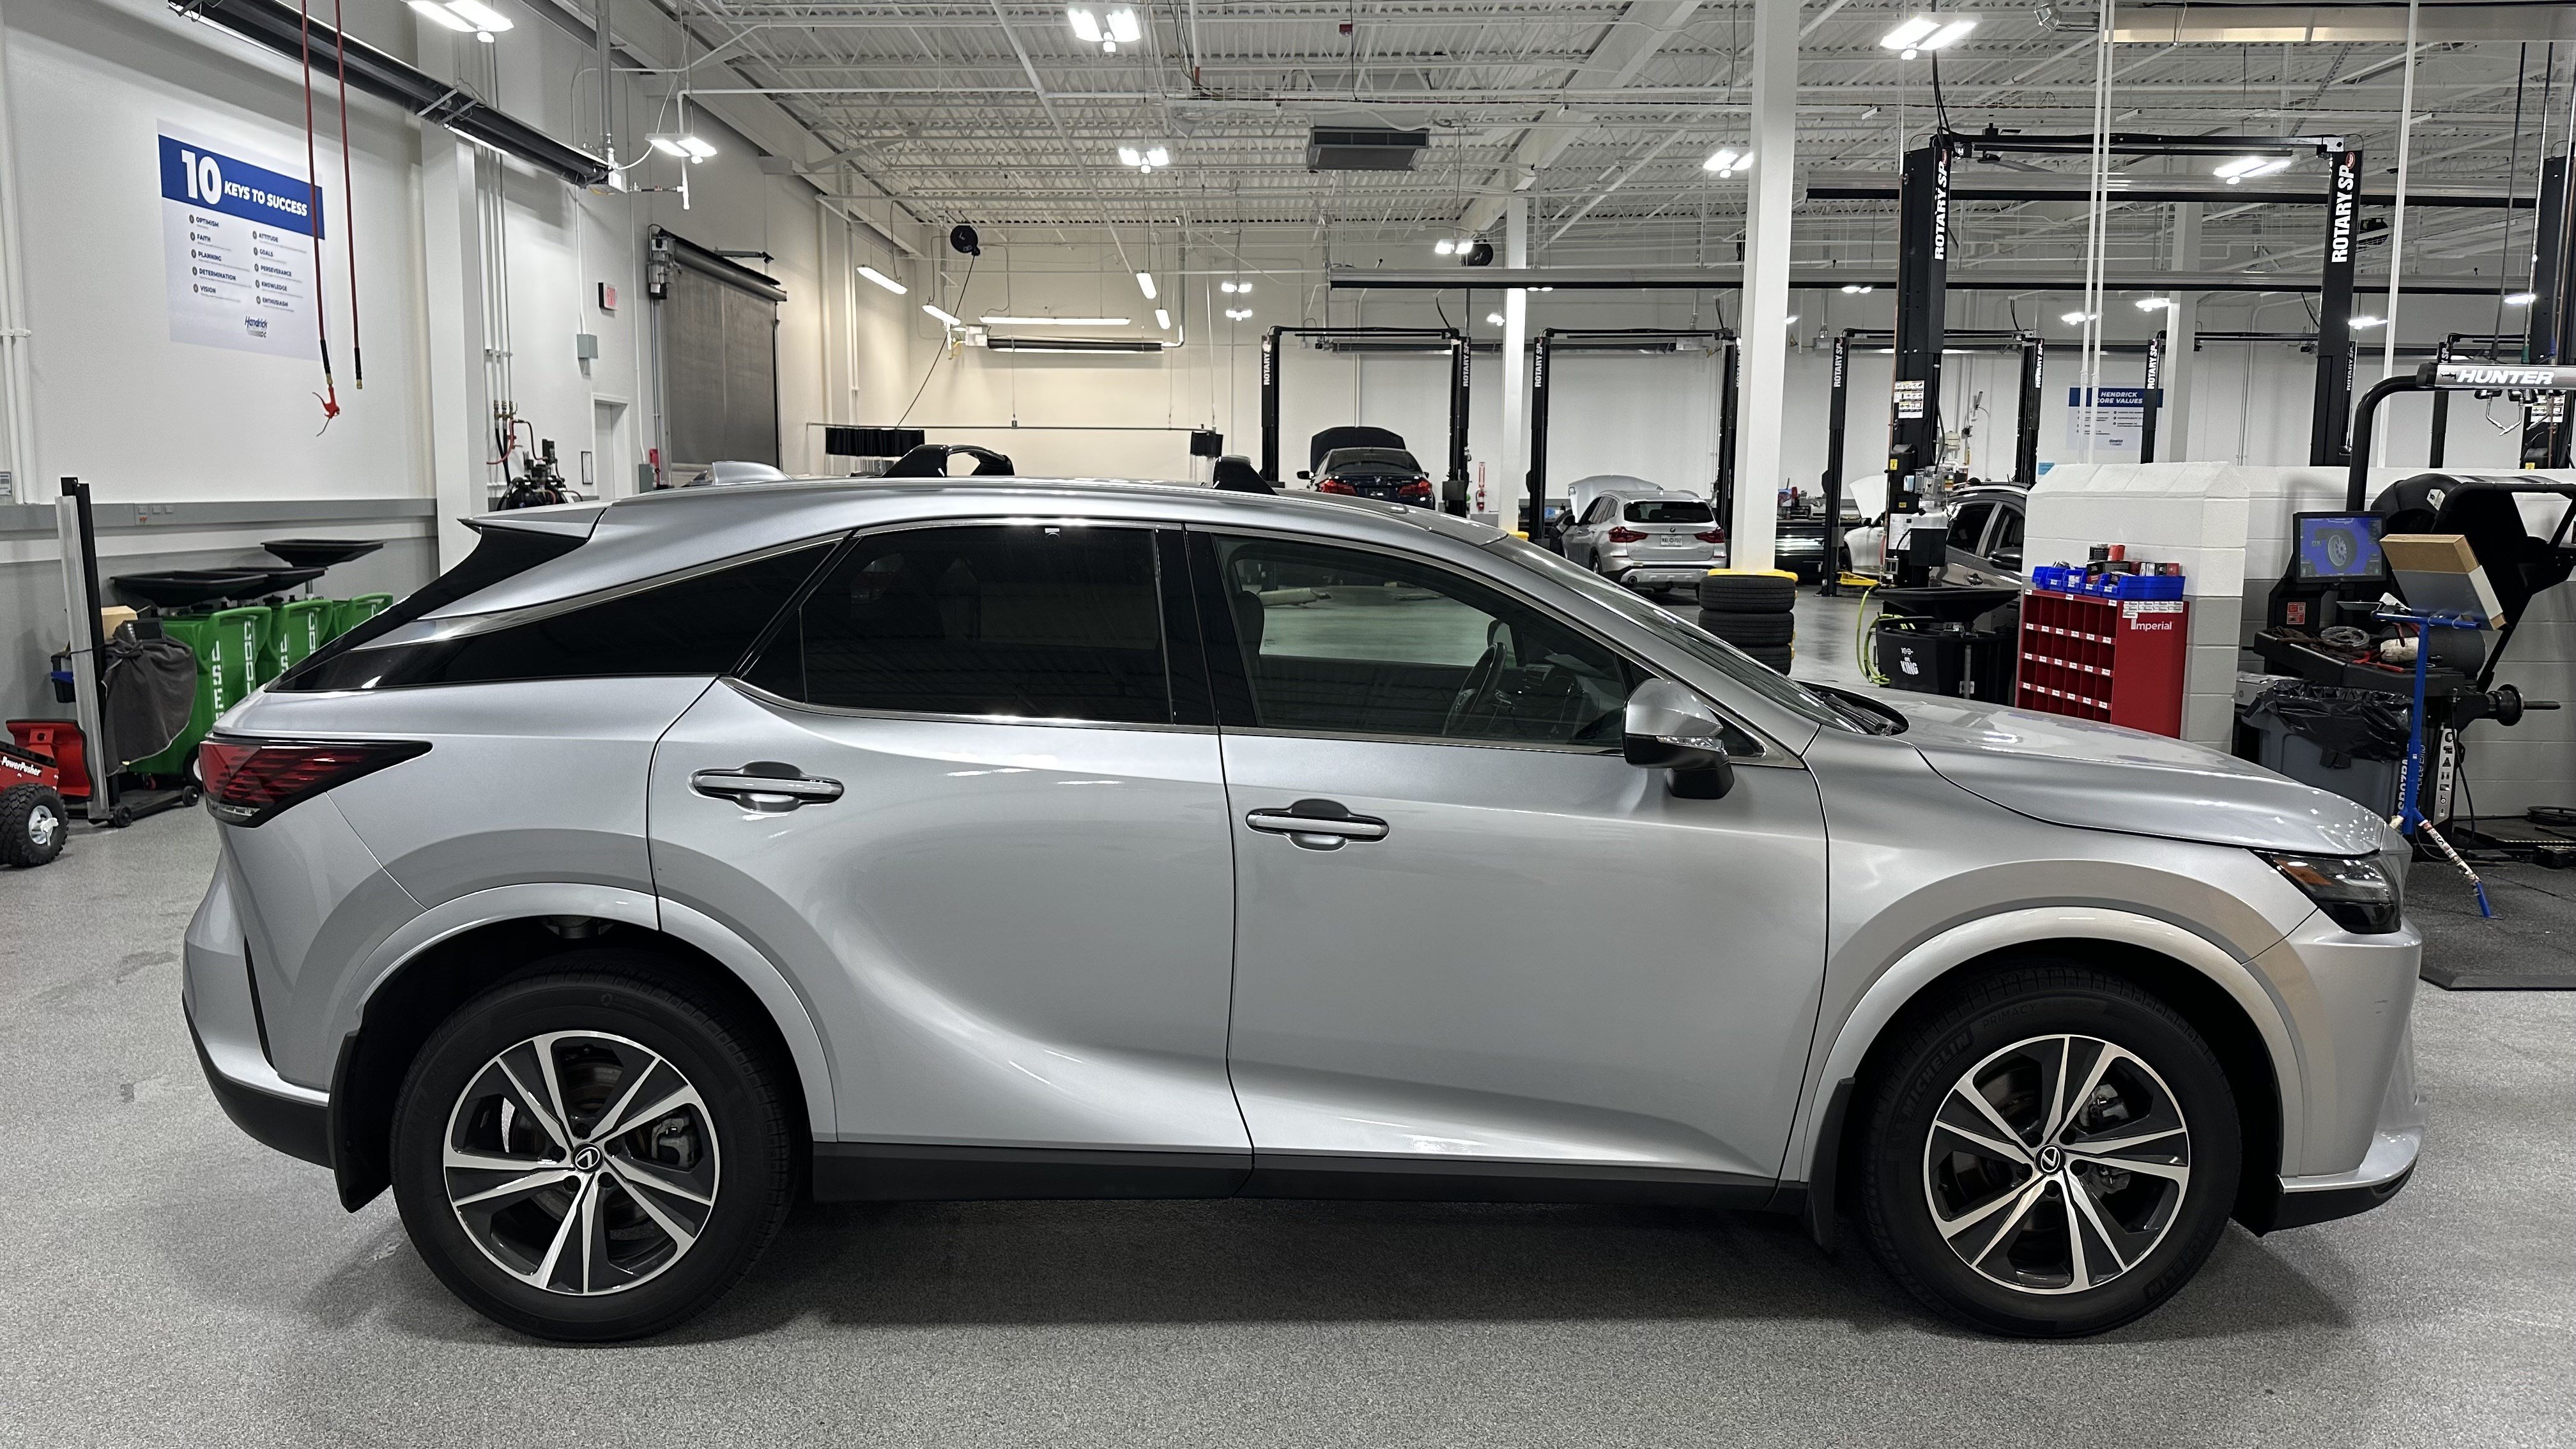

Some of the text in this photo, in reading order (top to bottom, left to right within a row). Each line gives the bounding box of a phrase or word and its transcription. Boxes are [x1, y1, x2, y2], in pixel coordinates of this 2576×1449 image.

[181, 149, 308, 217] 10 KEYS TO SUCCESS
[1935, 160, 1947, 260] ROTARY SP
[2331, 164, 2354, 263] ROTARY SP
[197, 233, 211, 242] FAITH
[199, 268, 236, 281] DETERMINATION
[200, 284, 216, 294] VISION
[244, 316, 268, 329] Hendrick
[1834, 342, 1843, 388] ROTARY SP
[2147, 344, 2158, 390] ROTARY SP
[2457, 369, 2555, 385] HUNTER
[2130, 618, 2172, 632] Imperial
[1900, 660, 1919, 675] KING
[1, 755, 42, 777] PowerPusher
[1981, 1003, 2038, 1030] PRIMACY
[1901, 1031, 1972, 1119] MICHELIN
